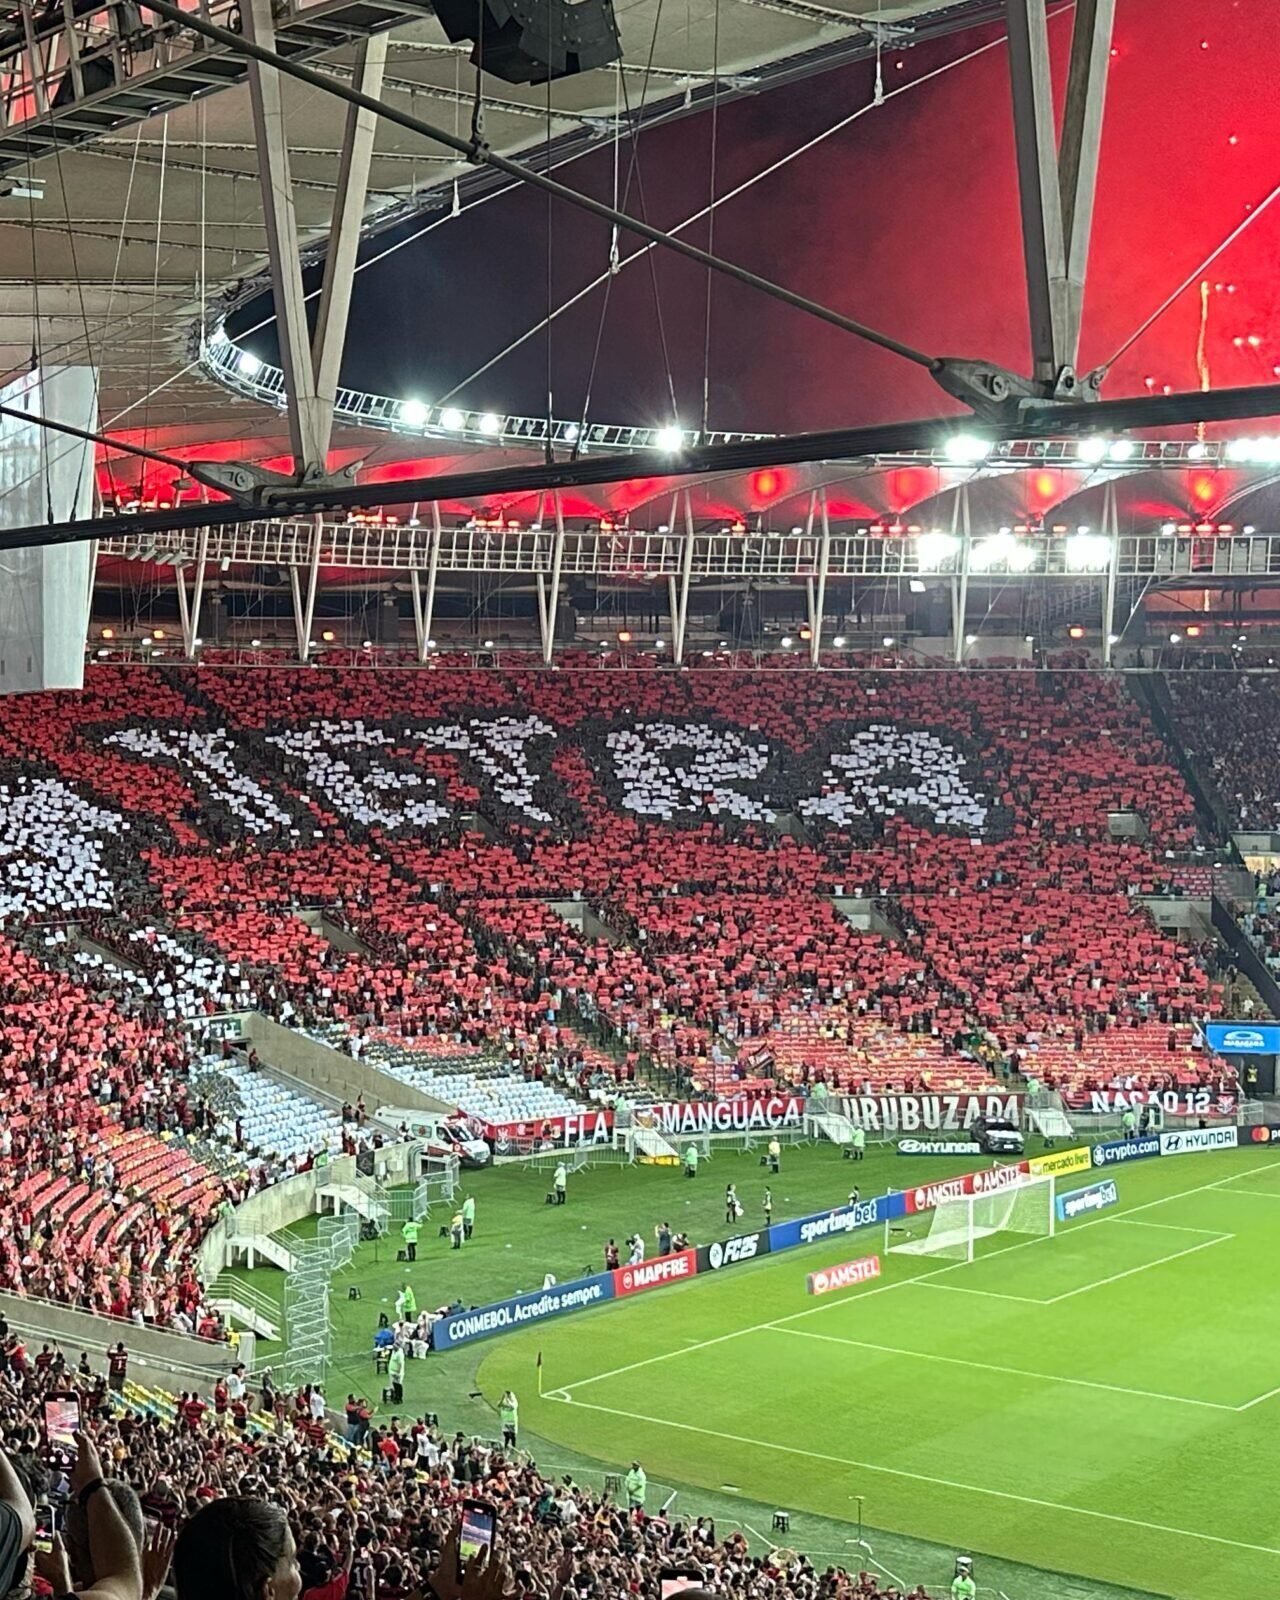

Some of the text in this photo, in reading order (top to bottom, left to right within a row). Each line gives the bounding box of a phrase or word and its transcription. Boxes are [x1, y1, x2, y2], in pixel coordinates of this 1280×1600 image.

[842, 1094, 1020, 1131] URUBUZADA
[1185, 1092, 1210, 1113] 12
[564, 1111, 609, 1147] FLA
[1185, 1131, 1235, 1147] HYUNDAI
[921, 1142, 980, 1153] HYUNDAI
[1105, 1140, 1159, 1160] crypto.com
[1042, 1155, 1074, 1173] mercado
[800, 1199, 877, 1242] sportingbet
[633, 1256, 689, 1287] MAPFRE
[829, 1256, 878, 1287] AMSTEL
[448, 1307, 513, 1341] CONMEBOL
[514, 1295, 560, 1322] Acredite
